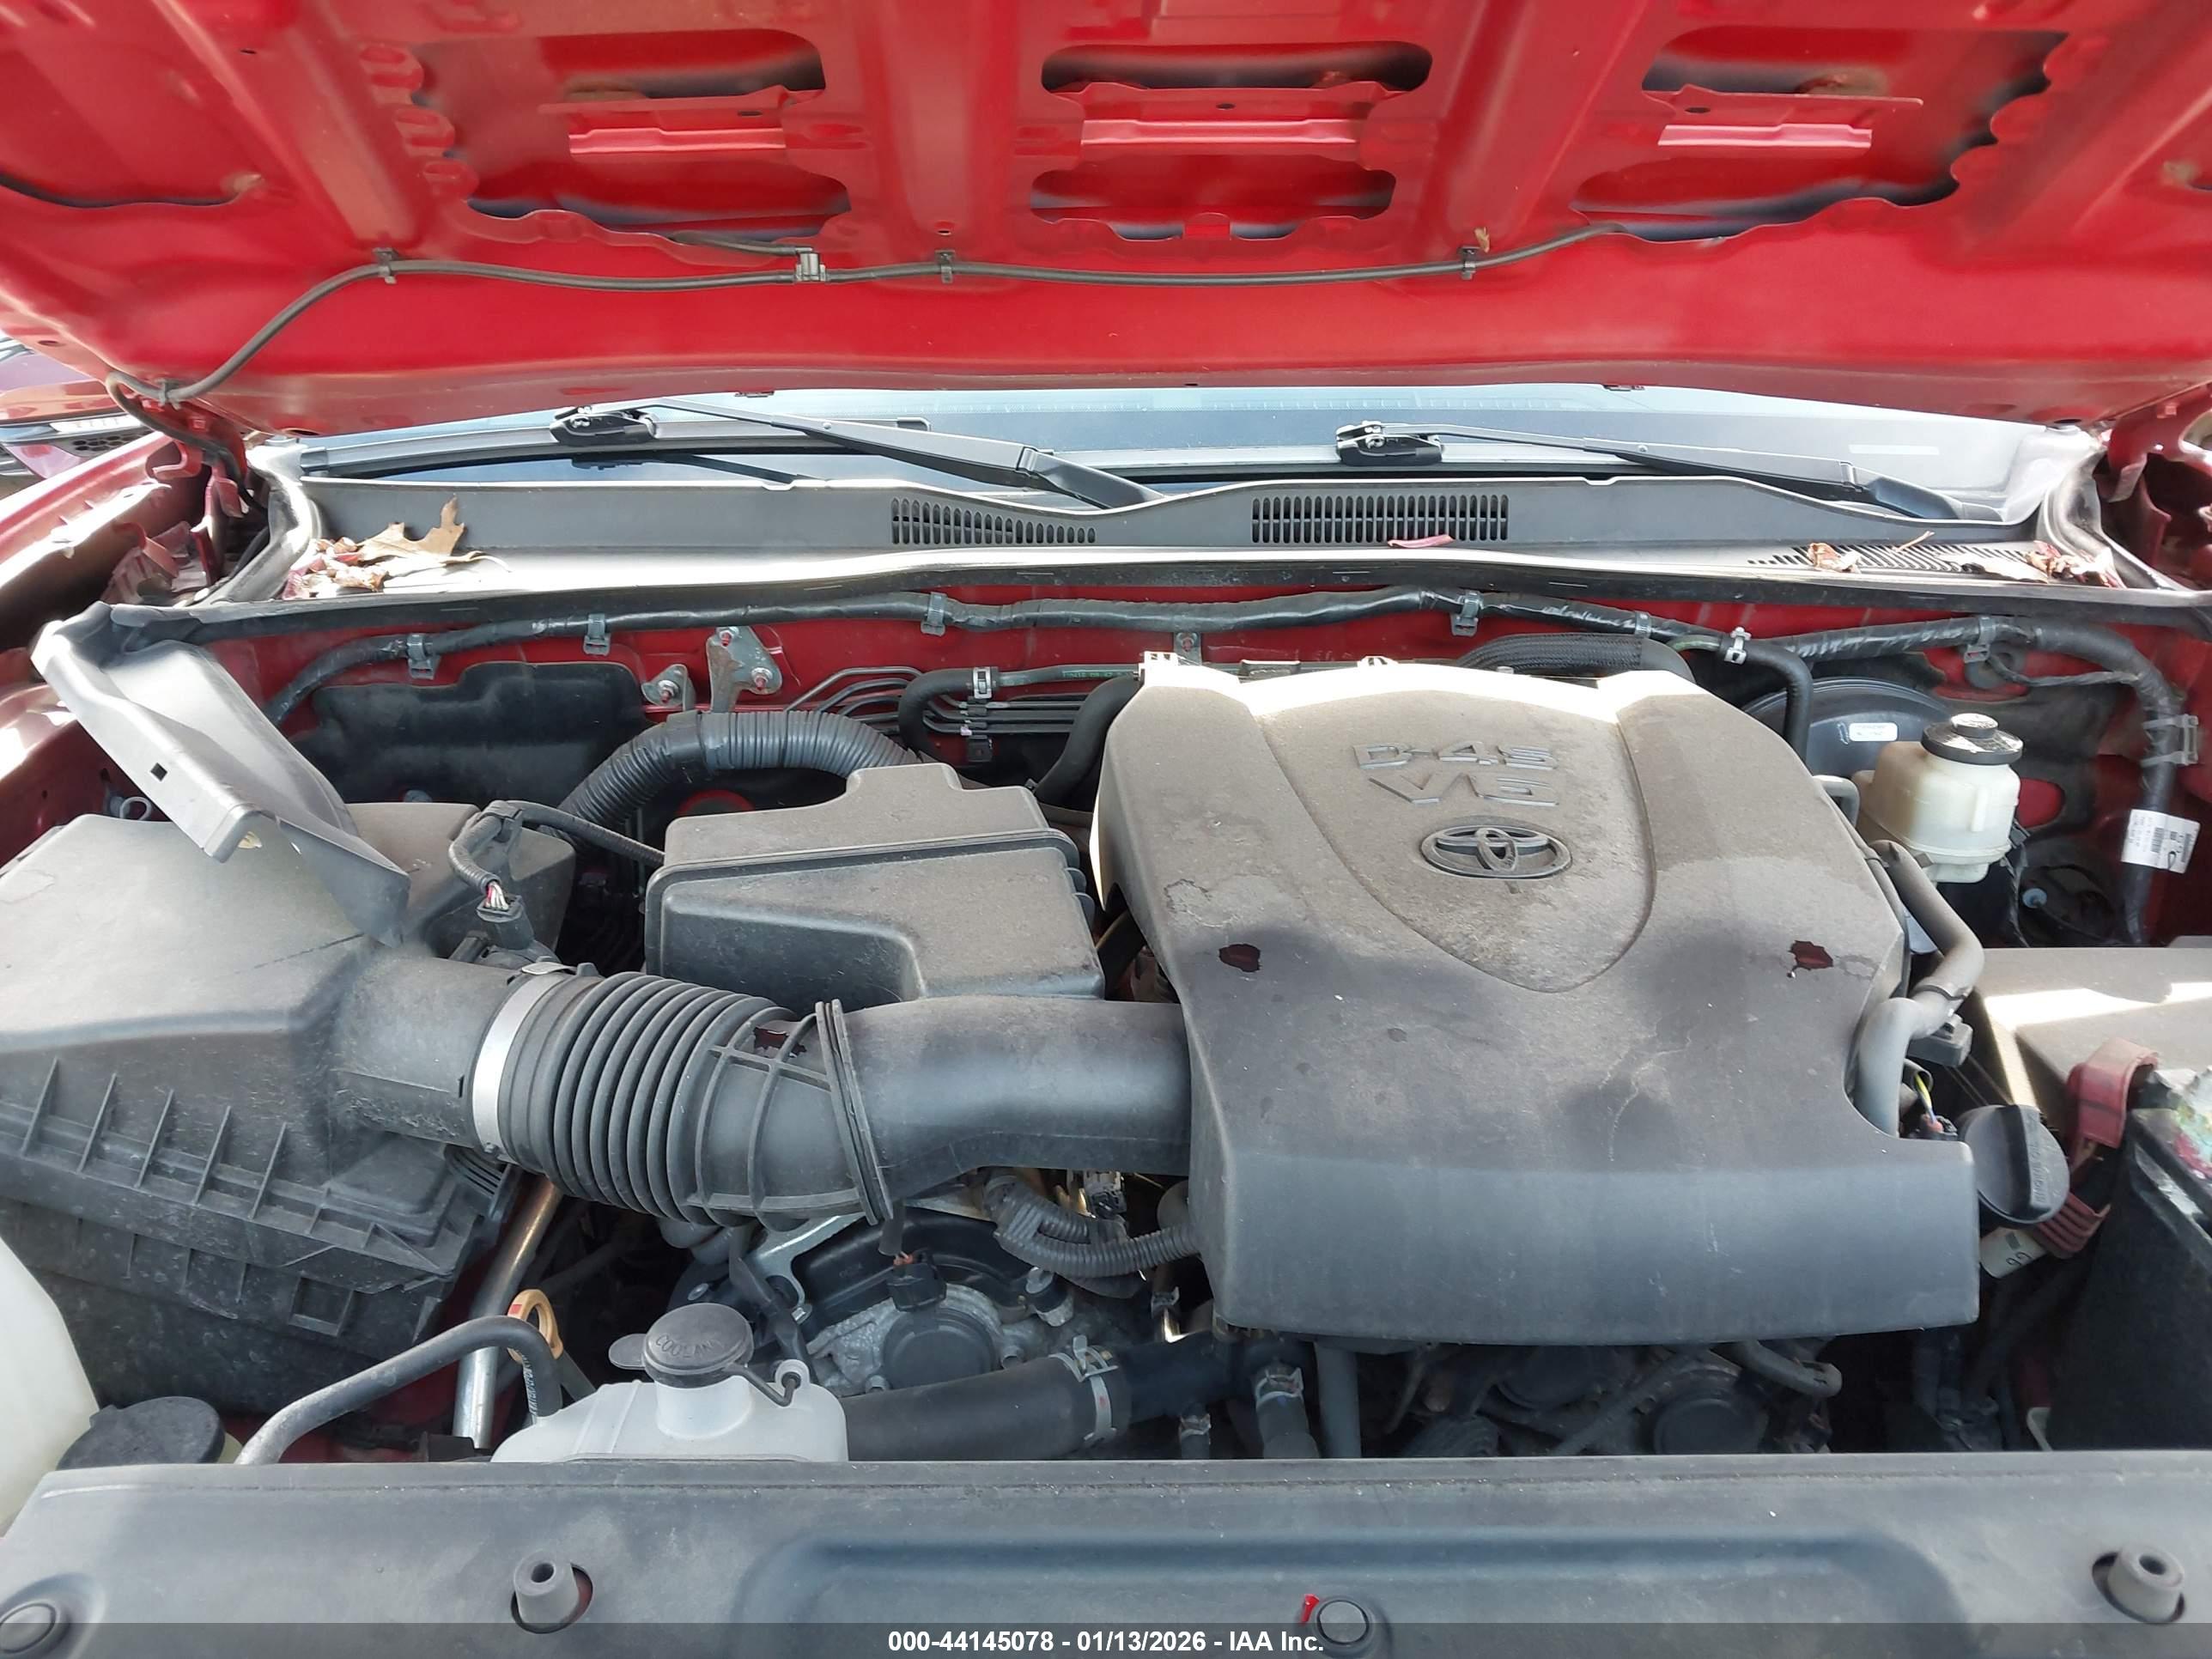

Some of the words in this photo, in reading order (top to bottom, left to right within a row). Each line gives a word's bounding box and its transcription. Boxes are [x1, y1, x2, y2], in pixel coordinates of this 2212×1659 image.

[1352, 741, 1559, 771] D-4S
[1368, 772, 1559, 807] V6
[656, 1334, 723, 1358] COOLANT
